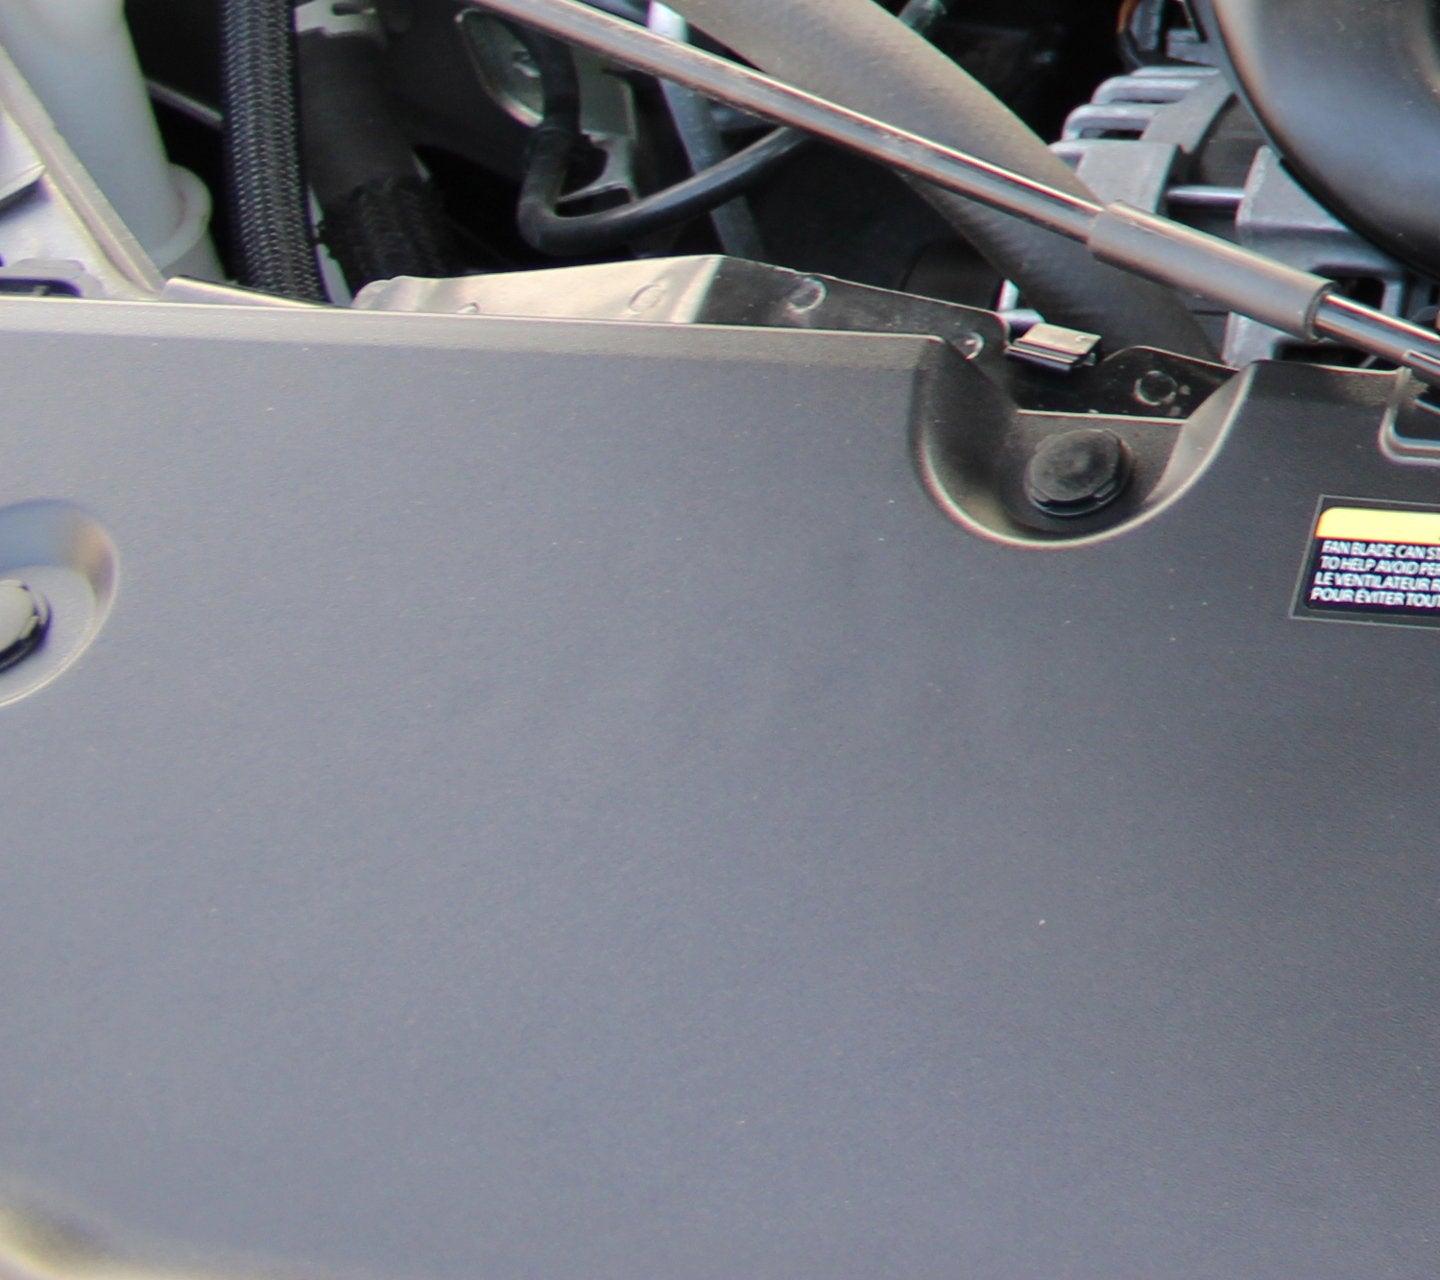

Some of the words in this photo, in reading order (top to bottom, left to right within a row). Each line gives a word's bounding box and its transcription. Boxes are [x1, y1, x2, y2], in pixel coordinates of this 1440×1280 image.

[1321, 540, 1349, 554] FAN
[1350, 542, 1395, 558] BLADE
[1395, 544, 1426, 559] CAN
[1320, 556, 1340, 570] TO
[1340, 557, 1376, 572] HELP
[1374, 560, 1419, 576] AVOID
[1315, 572, 1334, 586] LE
[1333, 573, 1432, 591] VENTILATEUR
[1310, 588, 1355, 603] POUR
[1354, 588, 1407, 607] ÉVITER
